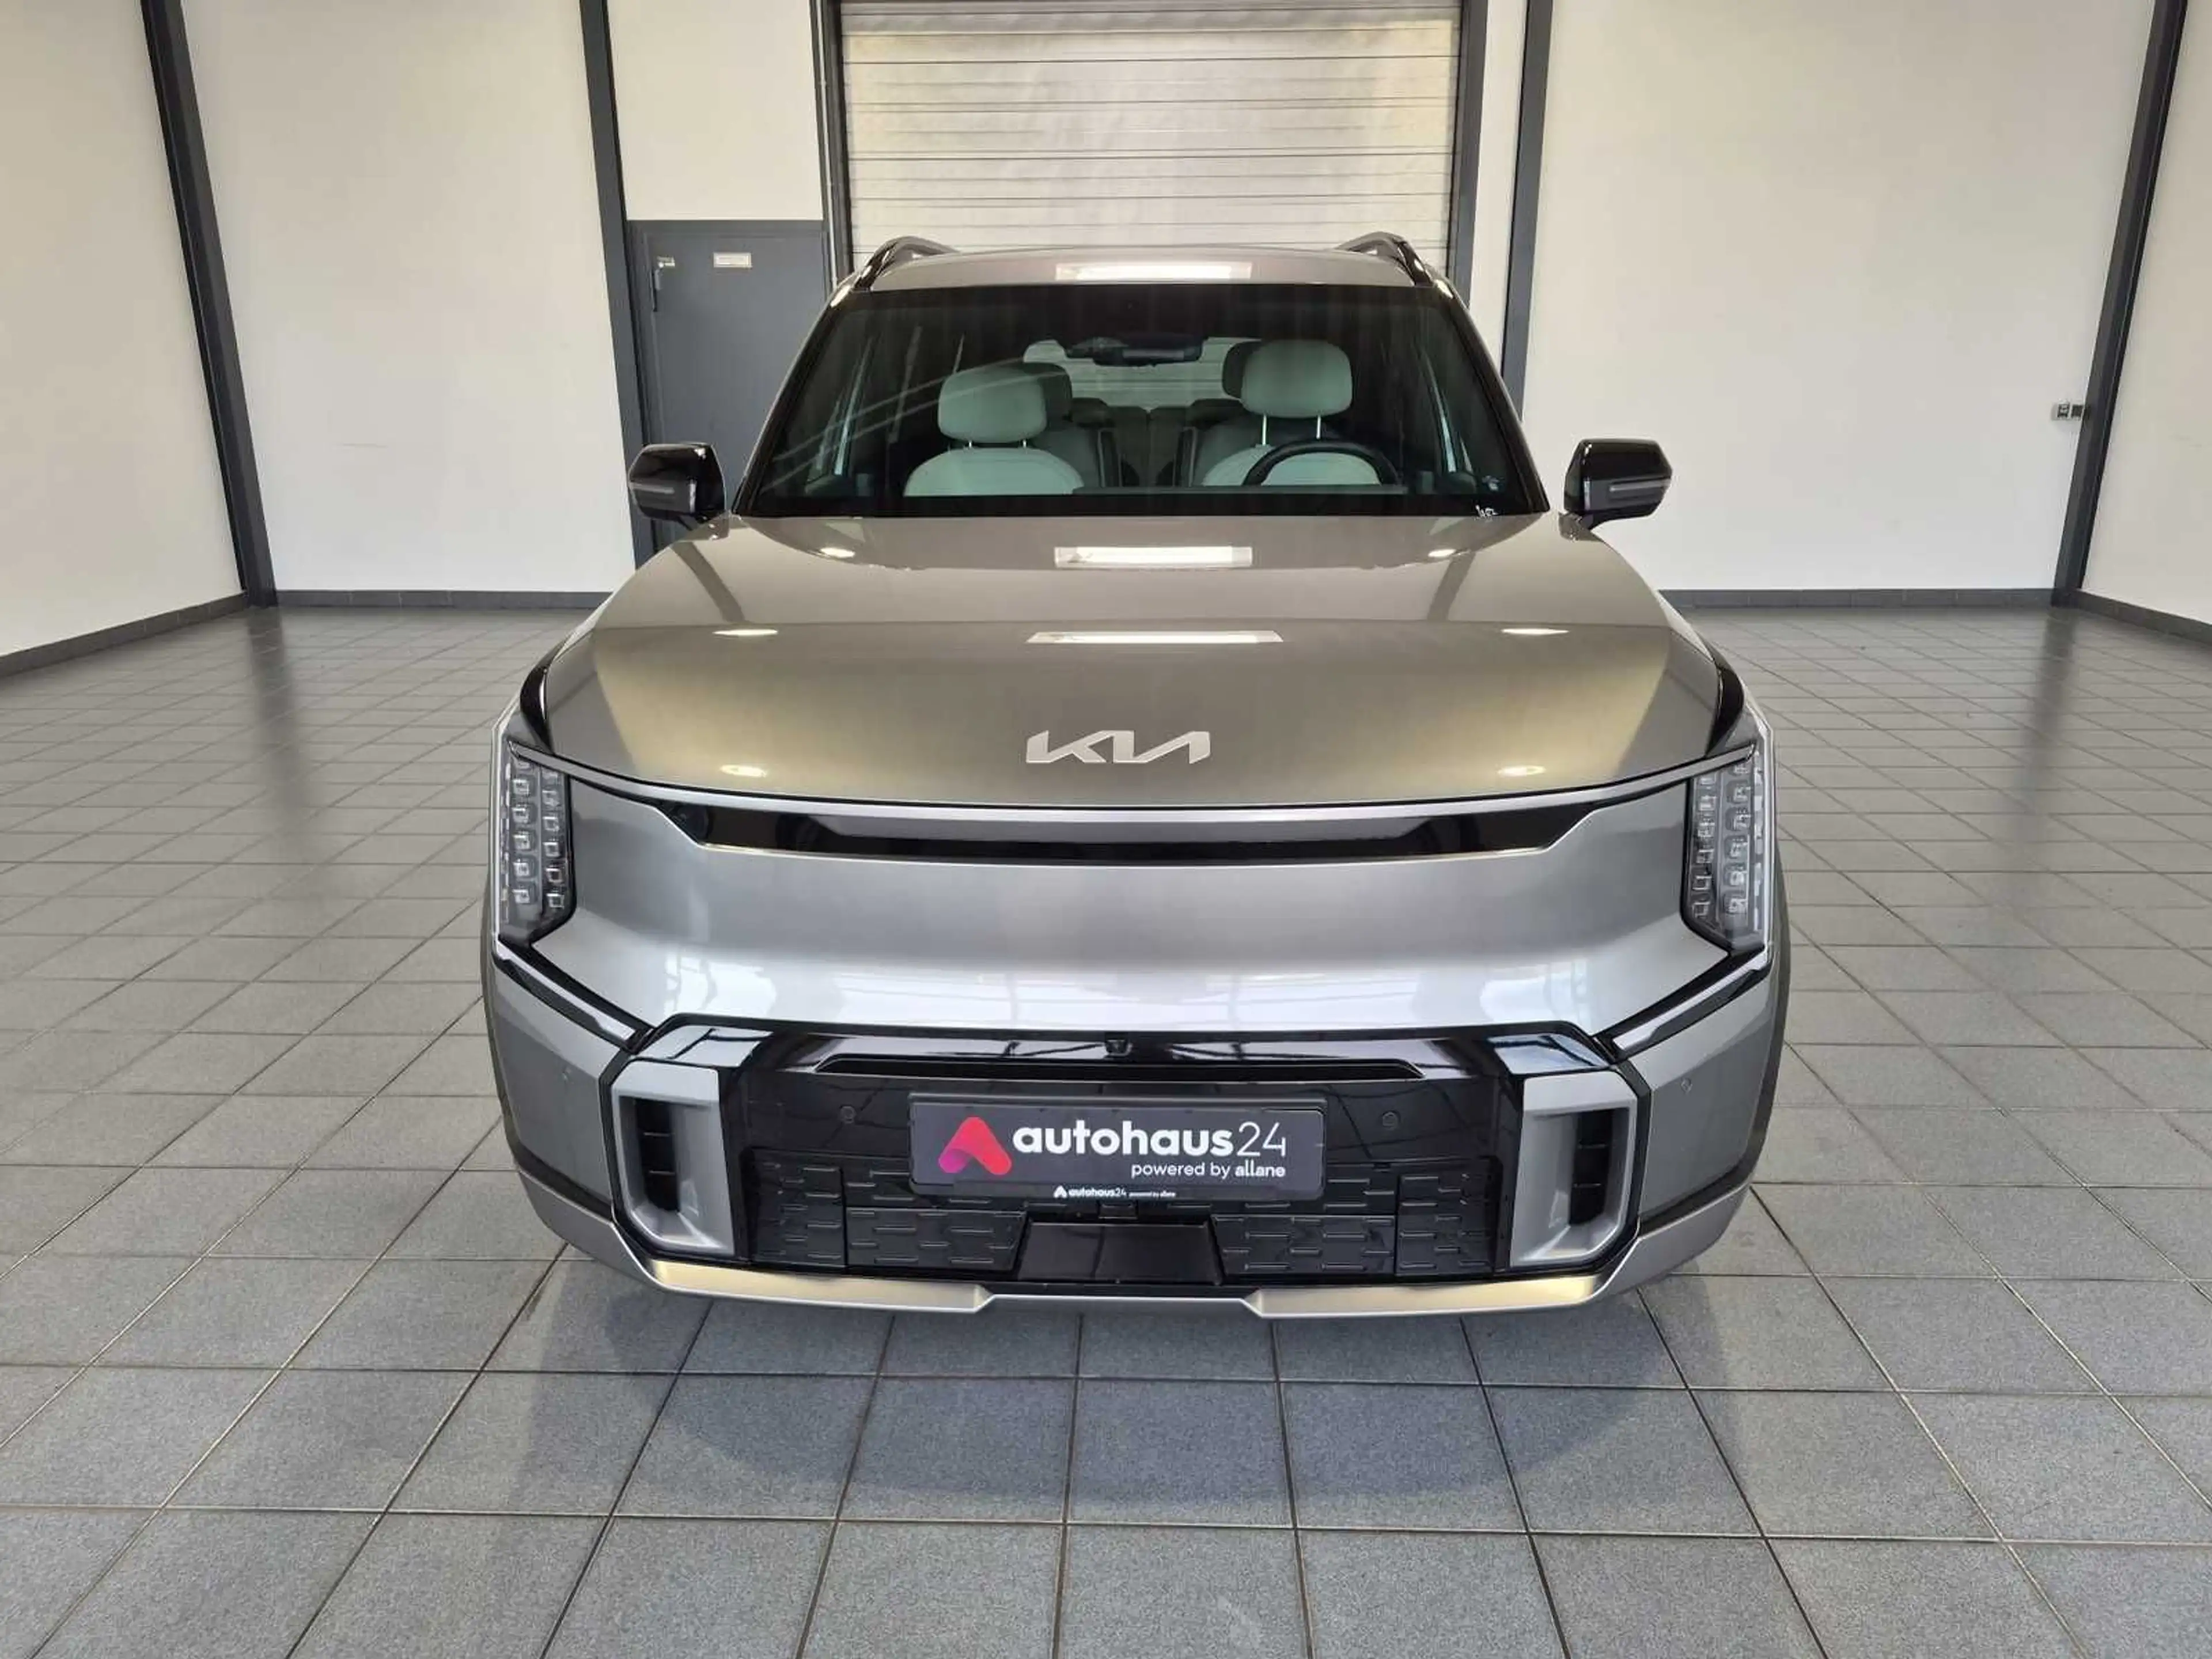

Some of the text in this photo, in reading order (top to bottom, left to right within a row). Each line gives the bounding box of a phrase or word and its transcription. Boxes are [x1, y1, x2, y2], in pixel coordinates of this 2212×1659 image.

[1025, 730, 1211, 764] KIA
[1012, 1119, 1286, 1157] autohaus24
[1131, 1159, 1286, 1180] powered by allane
